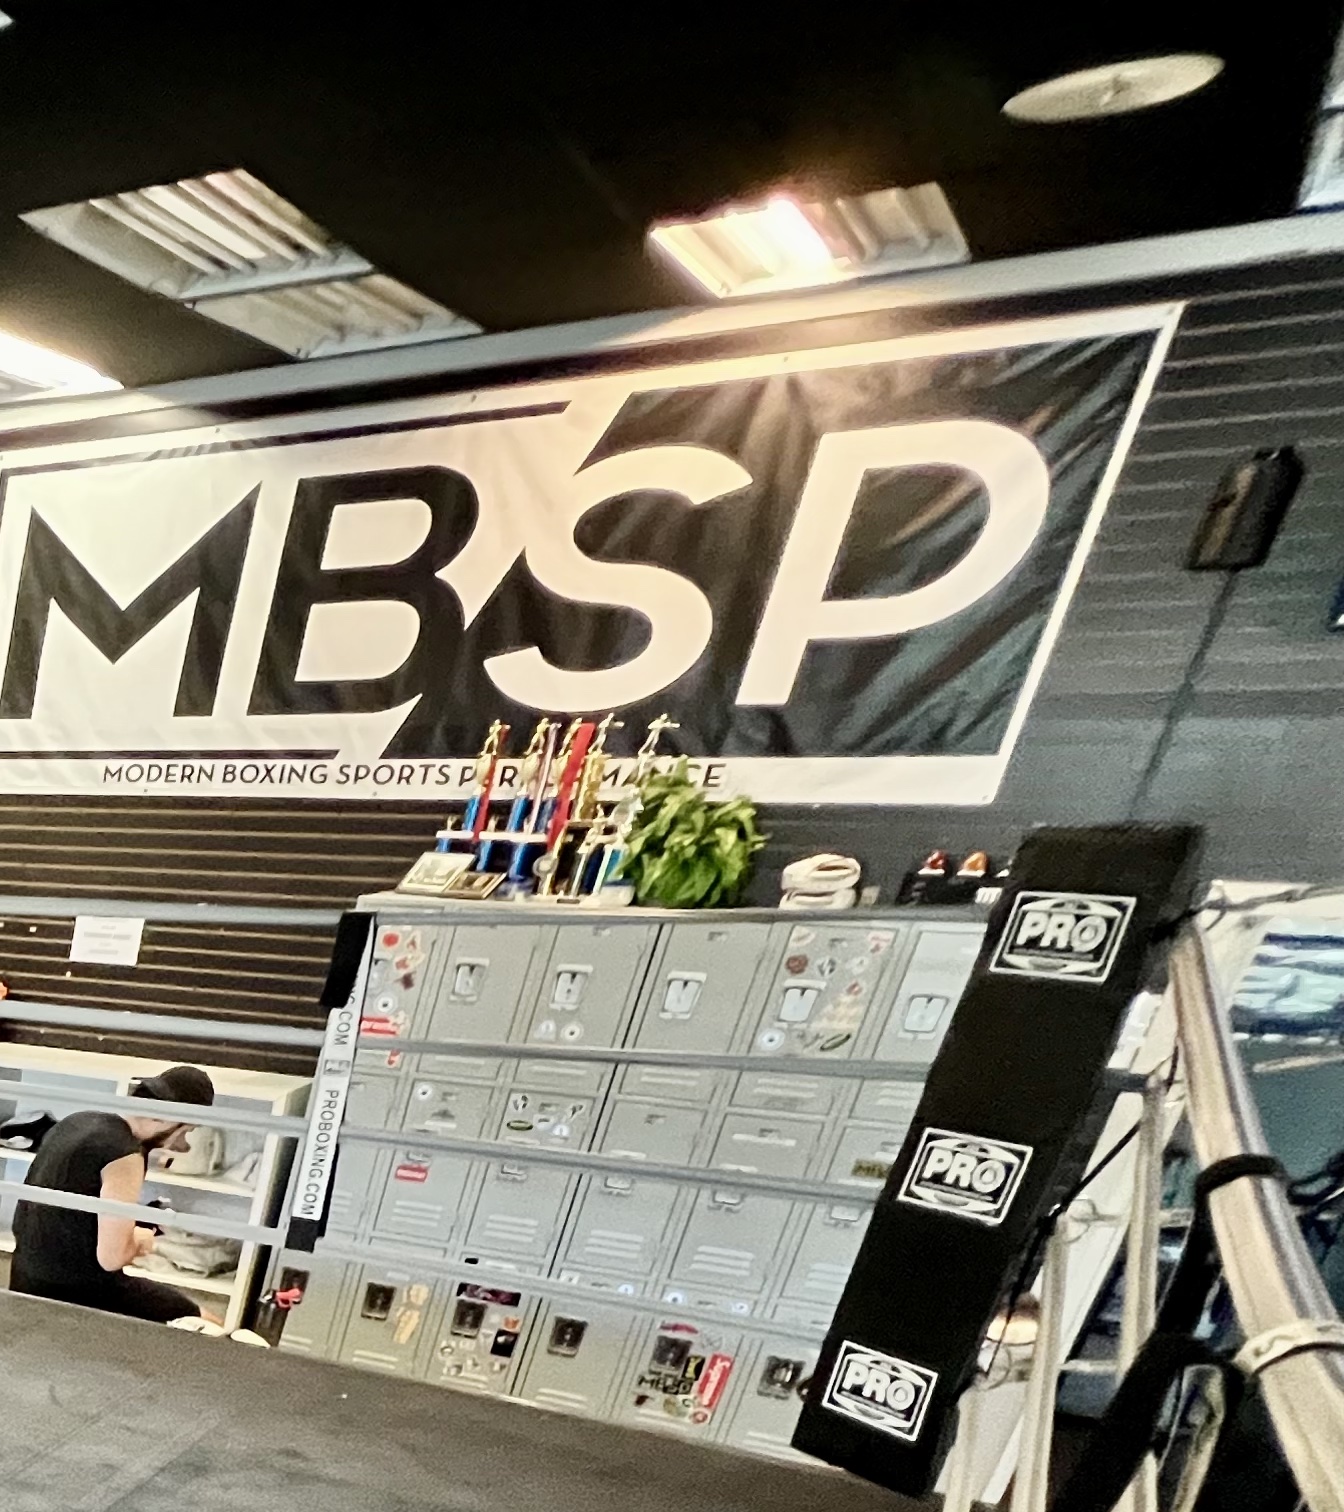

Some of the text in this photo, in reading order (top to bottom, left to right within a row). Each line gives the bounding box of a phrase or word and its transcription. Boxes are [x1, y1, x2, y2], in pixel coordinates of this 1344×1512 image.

[103, 763, 215, 784] MODERN
[222, 764, 328, 785] BOXING
[336, 764, 451, 787] SPORTS
[1016, 911, 1108, 953] PRO
[300, 1089, 340, 1215] PROBOXING.COM
[921, 1147, 1006, 1193] PRO
[841, 1361, 916, 1411] PRO
